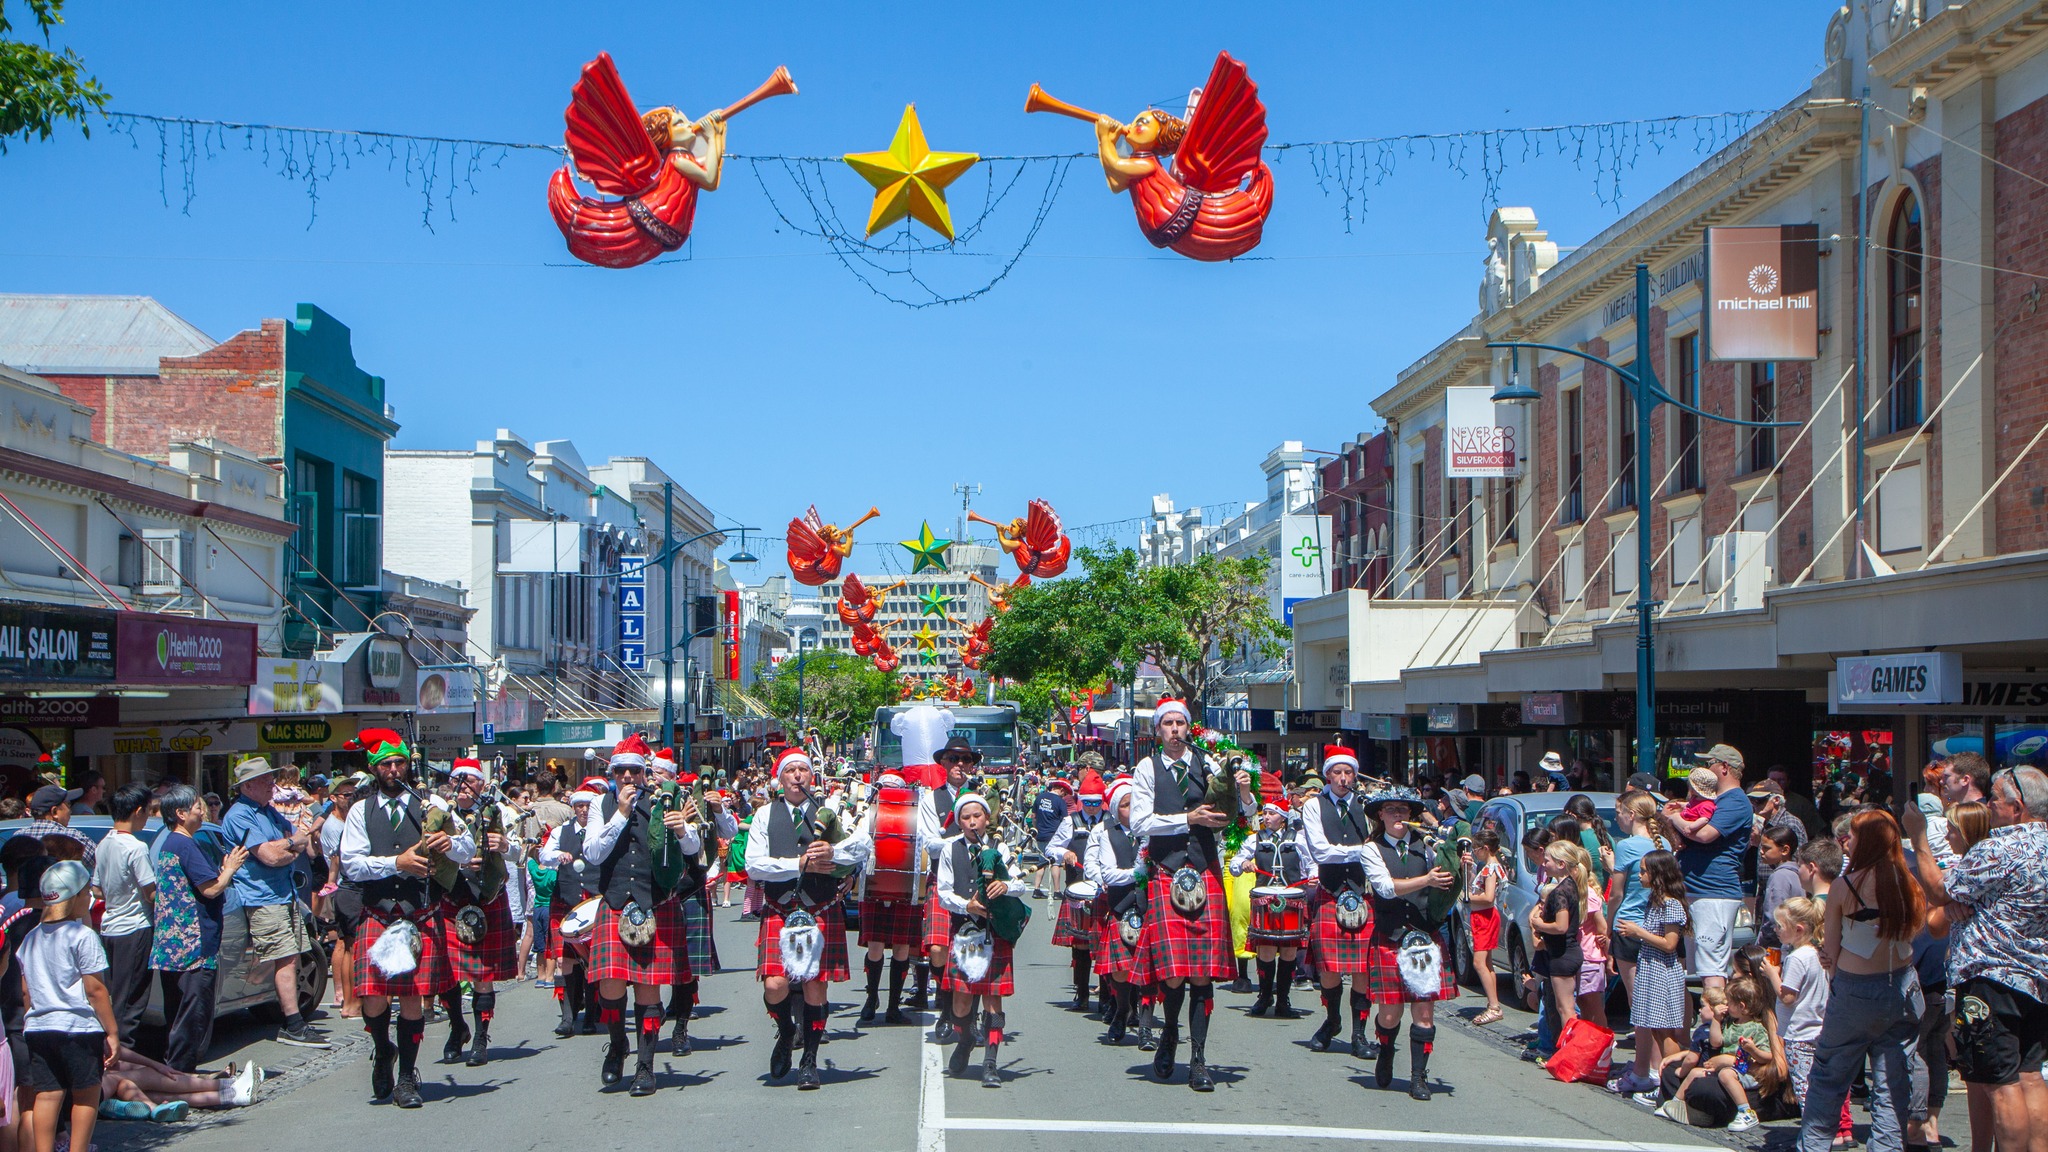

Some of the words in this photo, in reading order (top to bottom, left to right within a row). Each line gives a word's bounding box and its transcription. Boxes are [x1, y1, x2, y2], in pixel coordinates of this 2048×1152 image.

[1718, 296, 1783, 310] michael
[1451, 426, 1491, 439] NEVER
[1492, 425, 1515, 438] GO
[1452, 436, 1516, 453] NAKED
[1456, 455, 1512, 465] SILVERMOON
[620, 562, 643, 664] MALL
[28, 626, 79, 661] SALON
[170, 632, 198, 658] Health
[199, 636, 222, 659] 2000
[1871, 665, 1928, 693] GAMES
[273, 682, 299, 713] WHAT
[0, 699, 35, 714] alth
[38, 700, 89, 714] 2000
[1656, 701, 1704, 714] ichael
[1707, 701, 1730, 714] hill
[267, 724, 291, 740] MAC
[294, 724, 326, 739] SHAW
[113, 737, 162, 754] WHAT
[10, 749, 36, 759] Store
